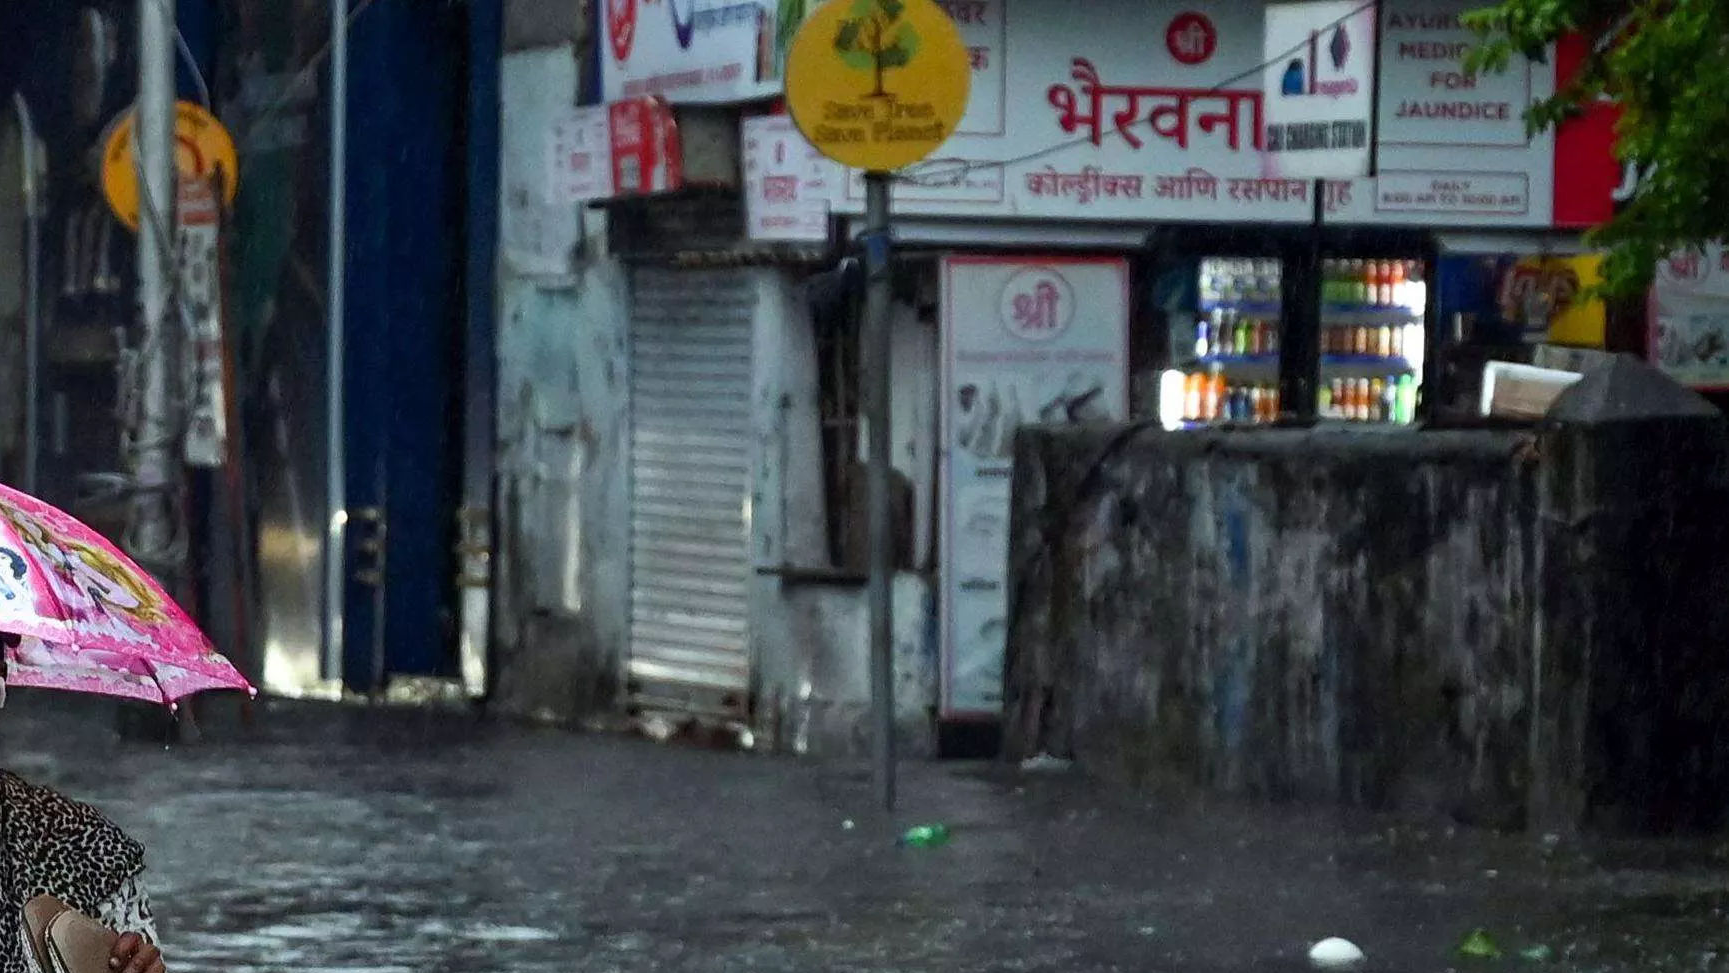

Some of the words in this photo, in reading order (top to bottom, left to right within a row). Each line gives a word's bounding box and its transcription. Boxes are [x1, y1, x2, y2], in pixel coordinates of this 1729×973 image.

[822, 101, 873, 119] Save
[1047, 57, 1265, 151] भैरवना
[1395, 101, 1511, 119] JAUNDICE
[813, 124, 865, 143] Save
[872, 121, 944, 142] Planet
[1154, 166, 1221, 201] आणि
[1227, 178, 1309, 202] रसपान
[1013, 279, 1059, 329] श्री
